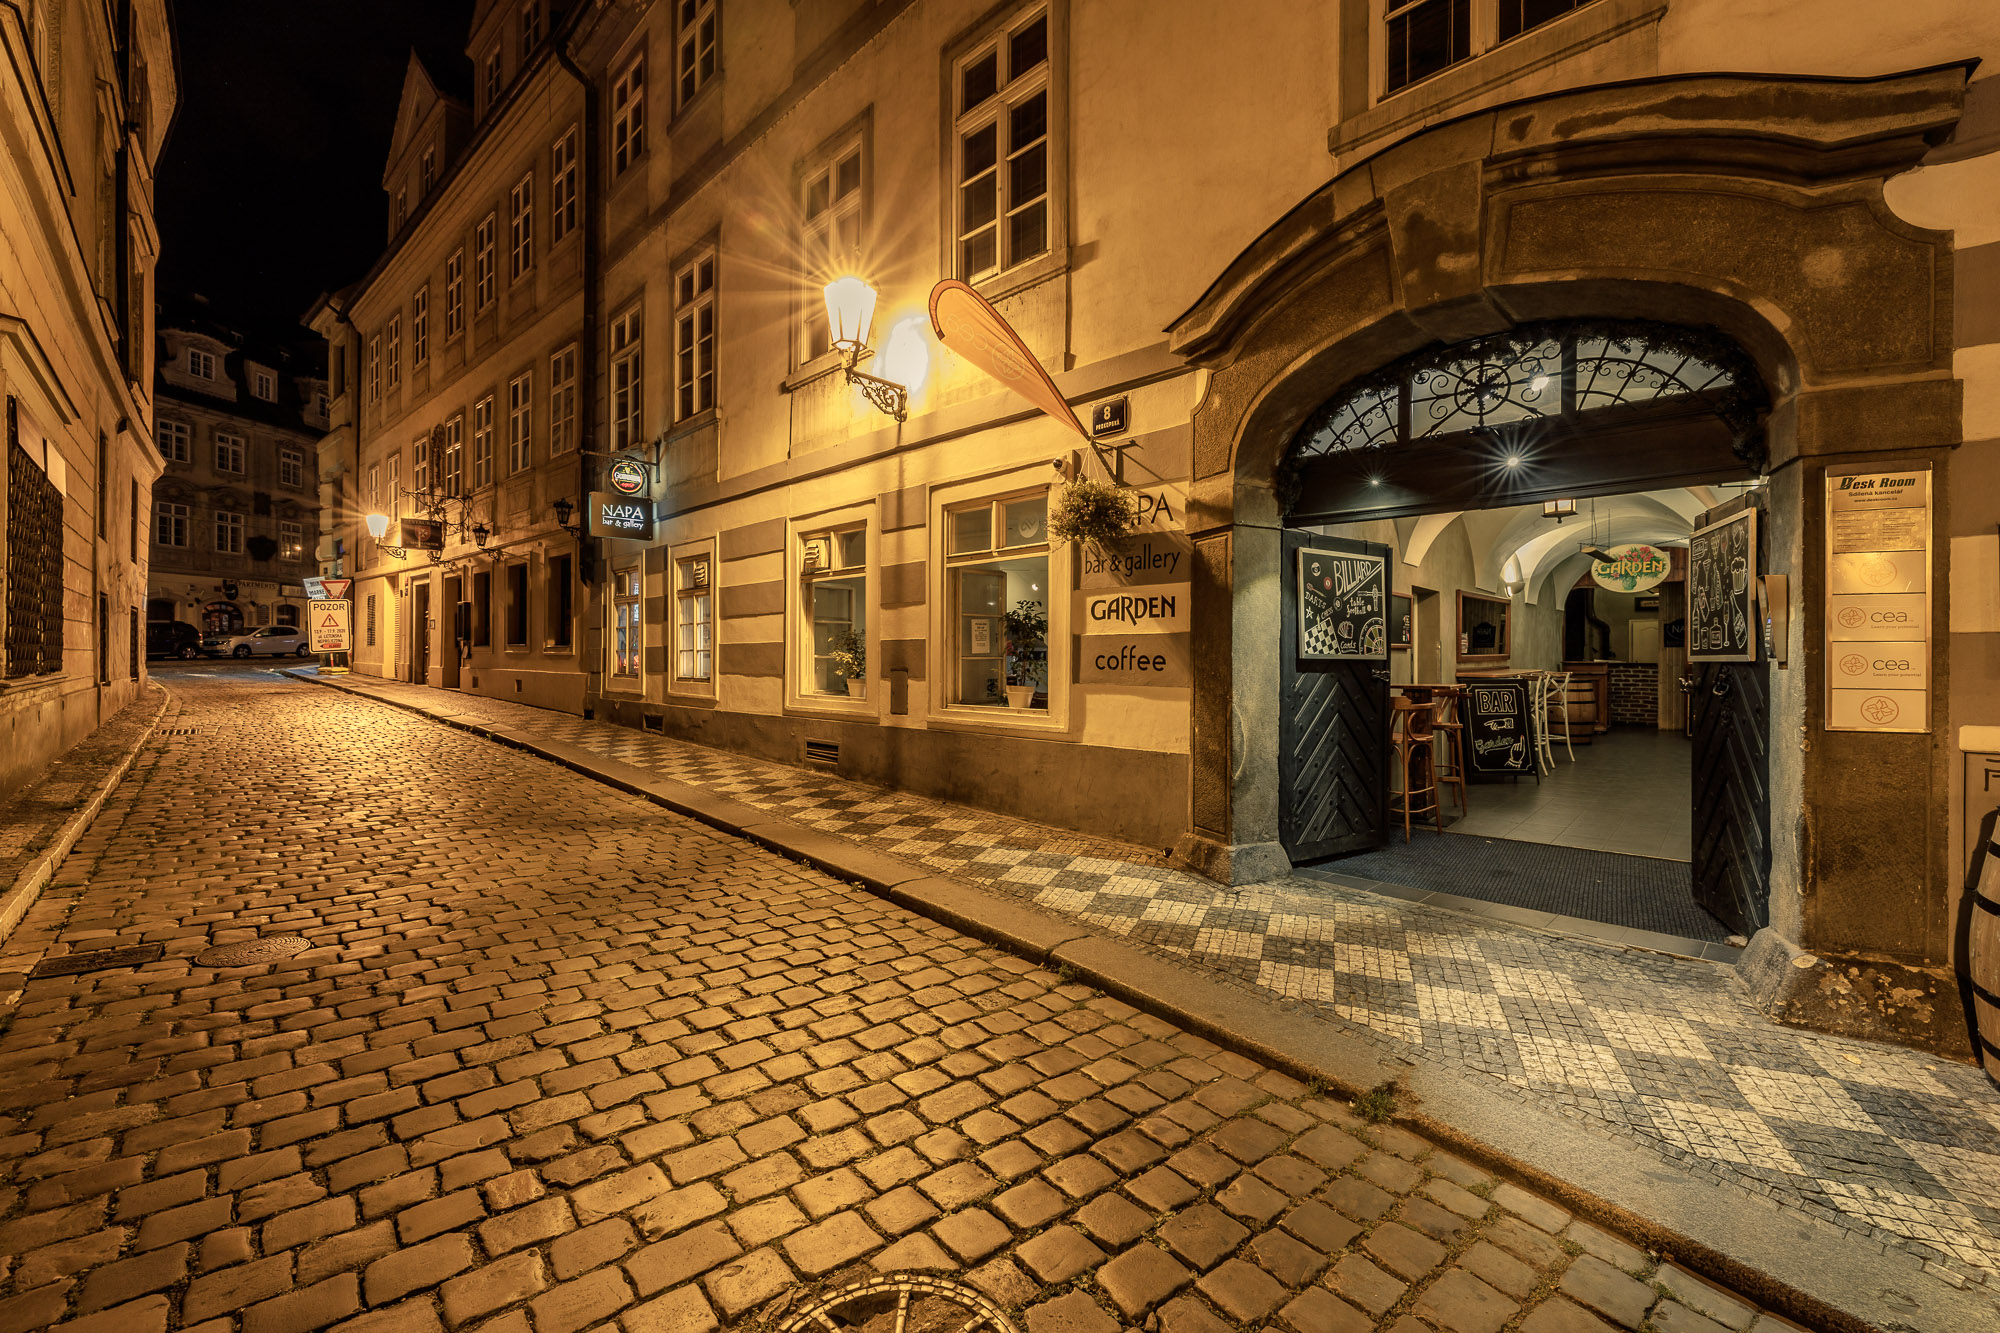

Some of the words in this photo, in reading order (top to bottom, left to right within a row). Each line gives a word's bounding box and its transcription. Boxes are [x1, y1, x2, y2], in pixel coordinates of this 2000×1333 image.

[1103, 405, 1111, 420] 8
[1839, 476, 1876, 490] Desk
[1880, 477, 1916, 488] Room
[602, 504, 643, 519] NAPA
[602, 517, 613, 525] bar
[1084, 549, 1107, 575] bar
[1109, 551, 1122, 573] &
[1125, 543, 1181, 578] gallery
[1597, 560, 1663, 577] GARDEN
[1333, 560, 1372, 597] BILLIARD
[1305, 591, 1327, 610] DARTS
[1349, 597, 1365, 607] table
[1090, 594, 1176, 626] GARDEN
[1346, 605, 1367, 618] football
[1870, 611, 1908, 623] cea
[1340, 640, 1357, 650] Cards
[1095, 644, 1167, 672] coffee
[1872, 659, 1910, 671] cea
[1480, 691, 1514, 713] BAR
[1474, 735, 1514, 755] Garden
